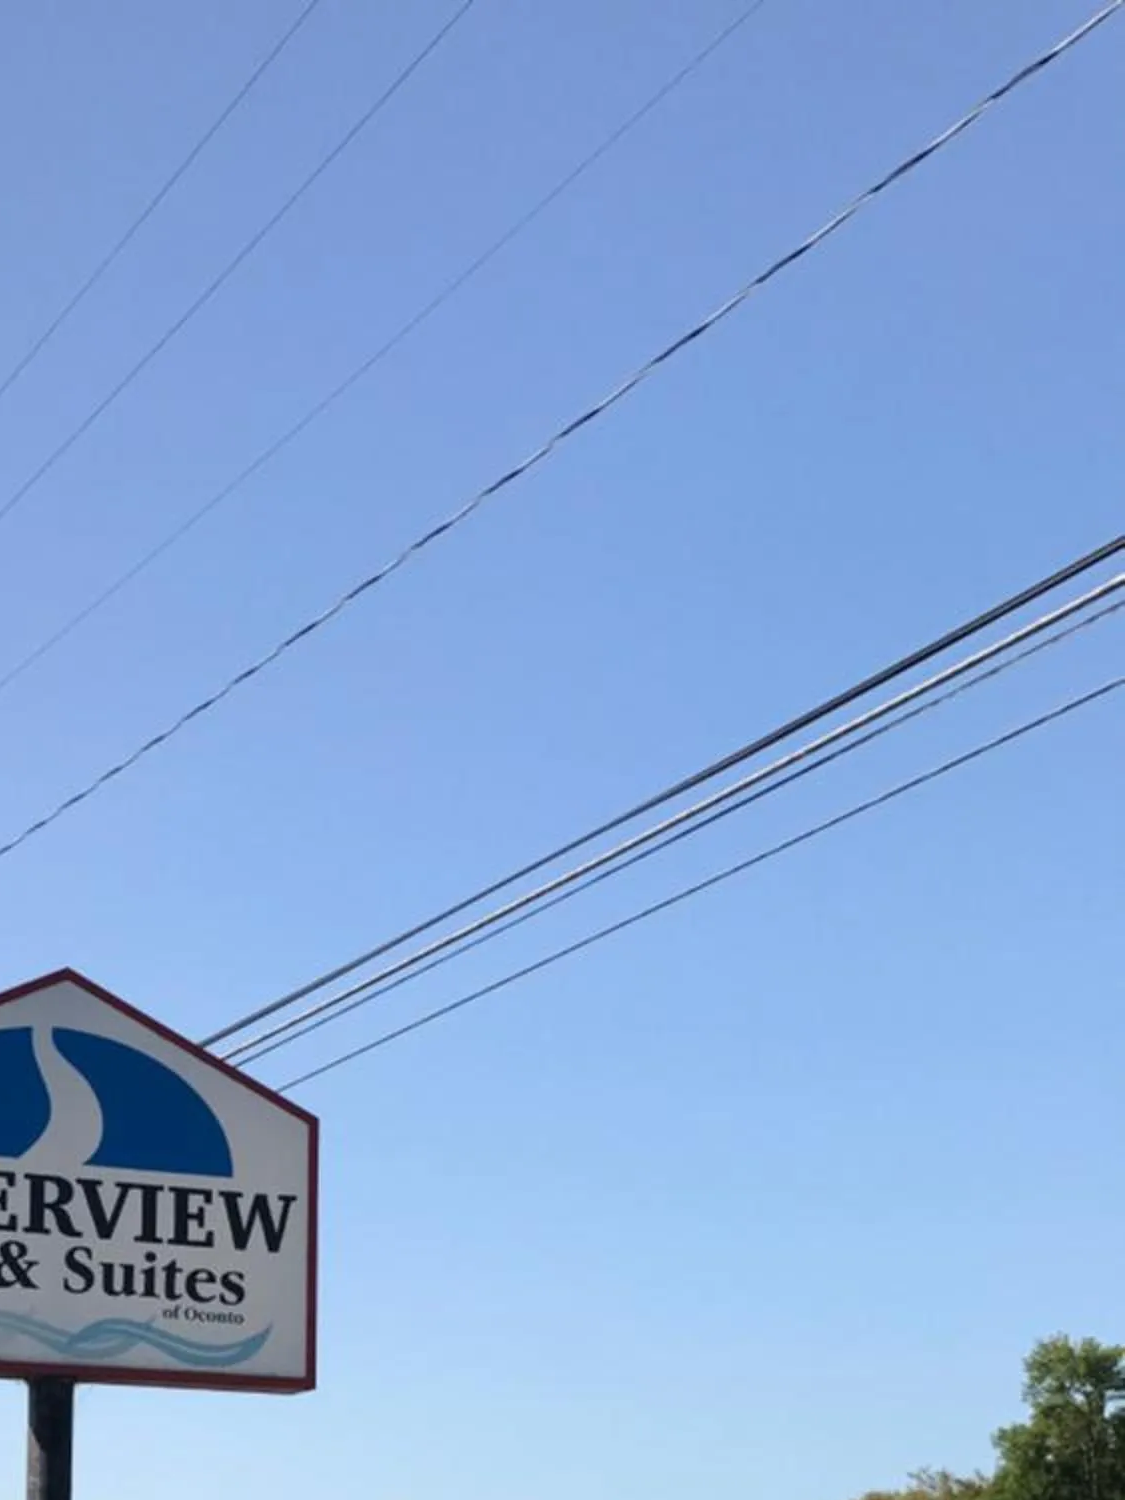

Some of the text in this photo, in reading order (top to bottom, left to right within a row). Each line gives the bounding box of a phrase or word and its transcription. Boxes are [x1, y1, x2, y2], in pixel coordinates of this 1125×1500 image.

[63, 1246, 247, 1306] Suites
[162, 1305, 245, 1325] of Oconto
